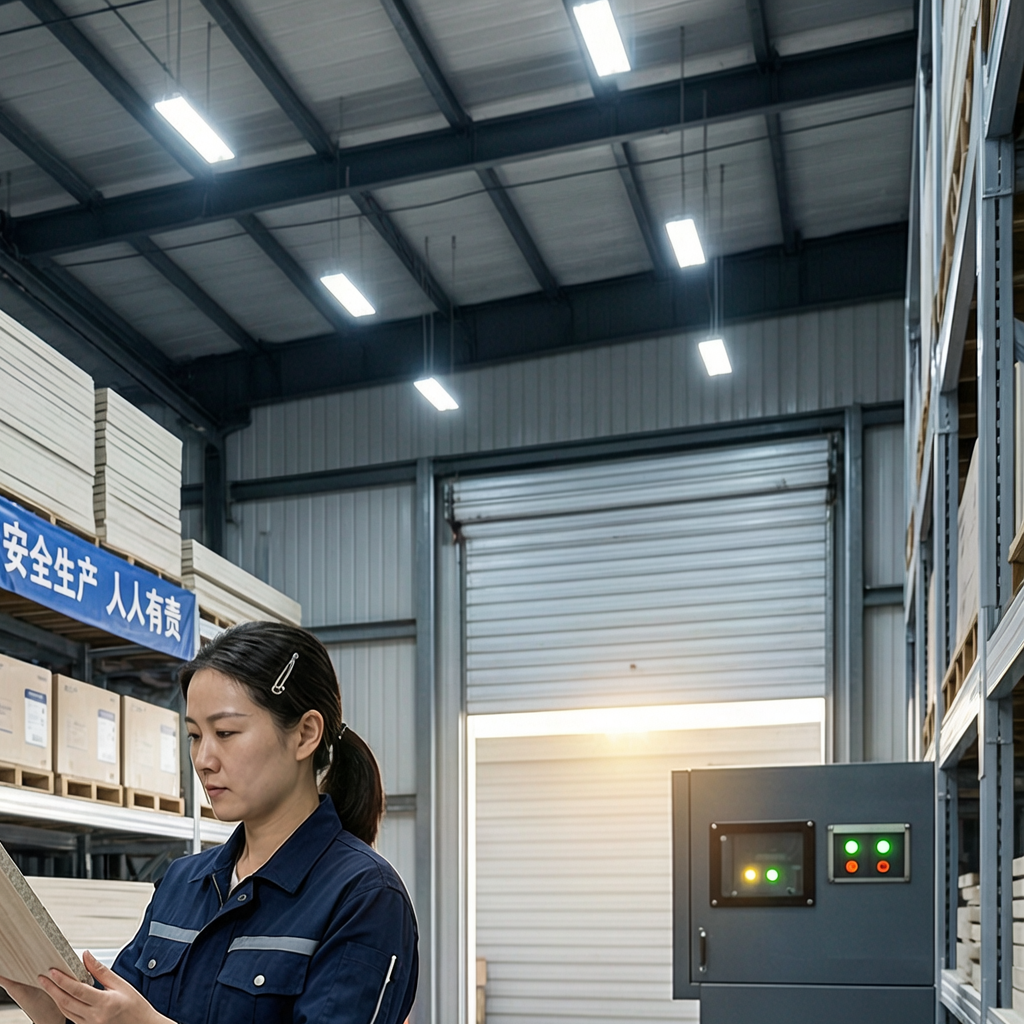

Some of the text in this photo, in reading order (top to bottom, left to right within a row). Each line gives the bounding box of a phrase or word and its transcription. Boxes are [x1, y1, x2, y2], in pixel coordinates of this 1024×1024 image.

[2, 521, 182, 642] 安全生产 人人有责
